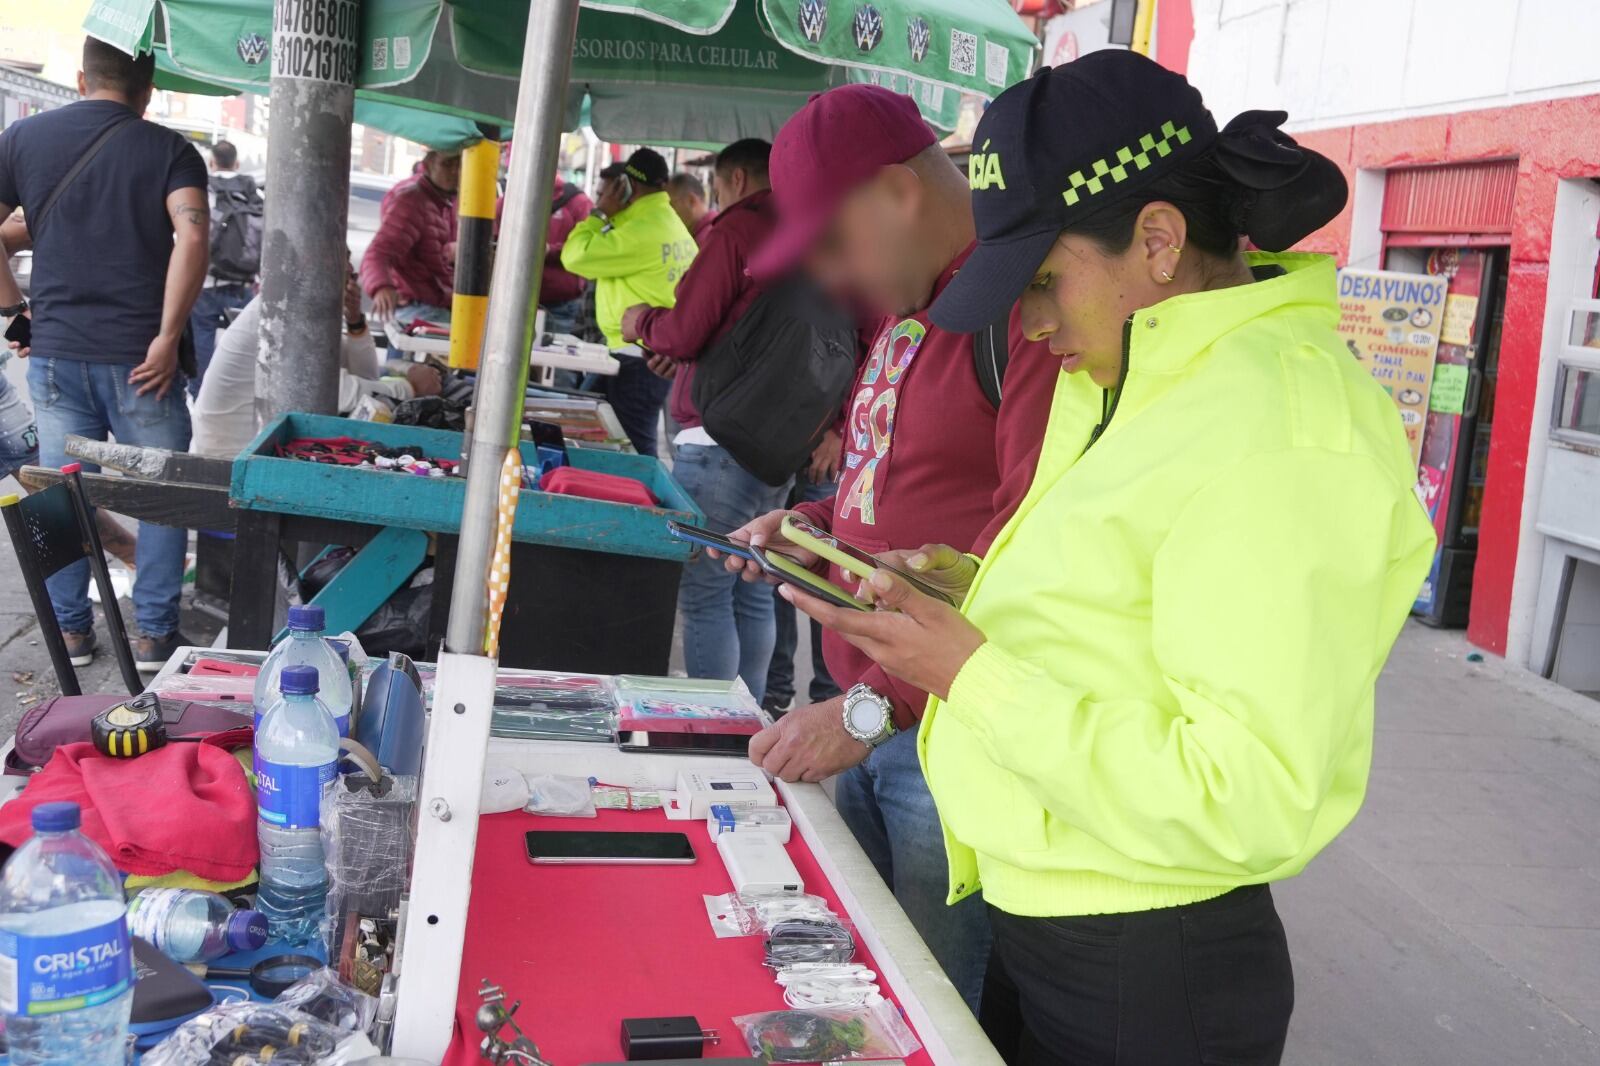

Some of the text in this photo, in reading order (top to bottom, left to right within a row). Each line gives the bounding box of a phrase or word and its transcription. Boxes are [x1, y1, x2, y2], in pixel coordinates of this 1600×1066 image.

[651, 42, 694, 63] PARA
[698, 45, 778, 69] CELULAR
[1341, 275, 1442, 306] DESAYUNOS
[851, 387, 897, 453] GO
[34, 939, 122, 975] CRISTAL
